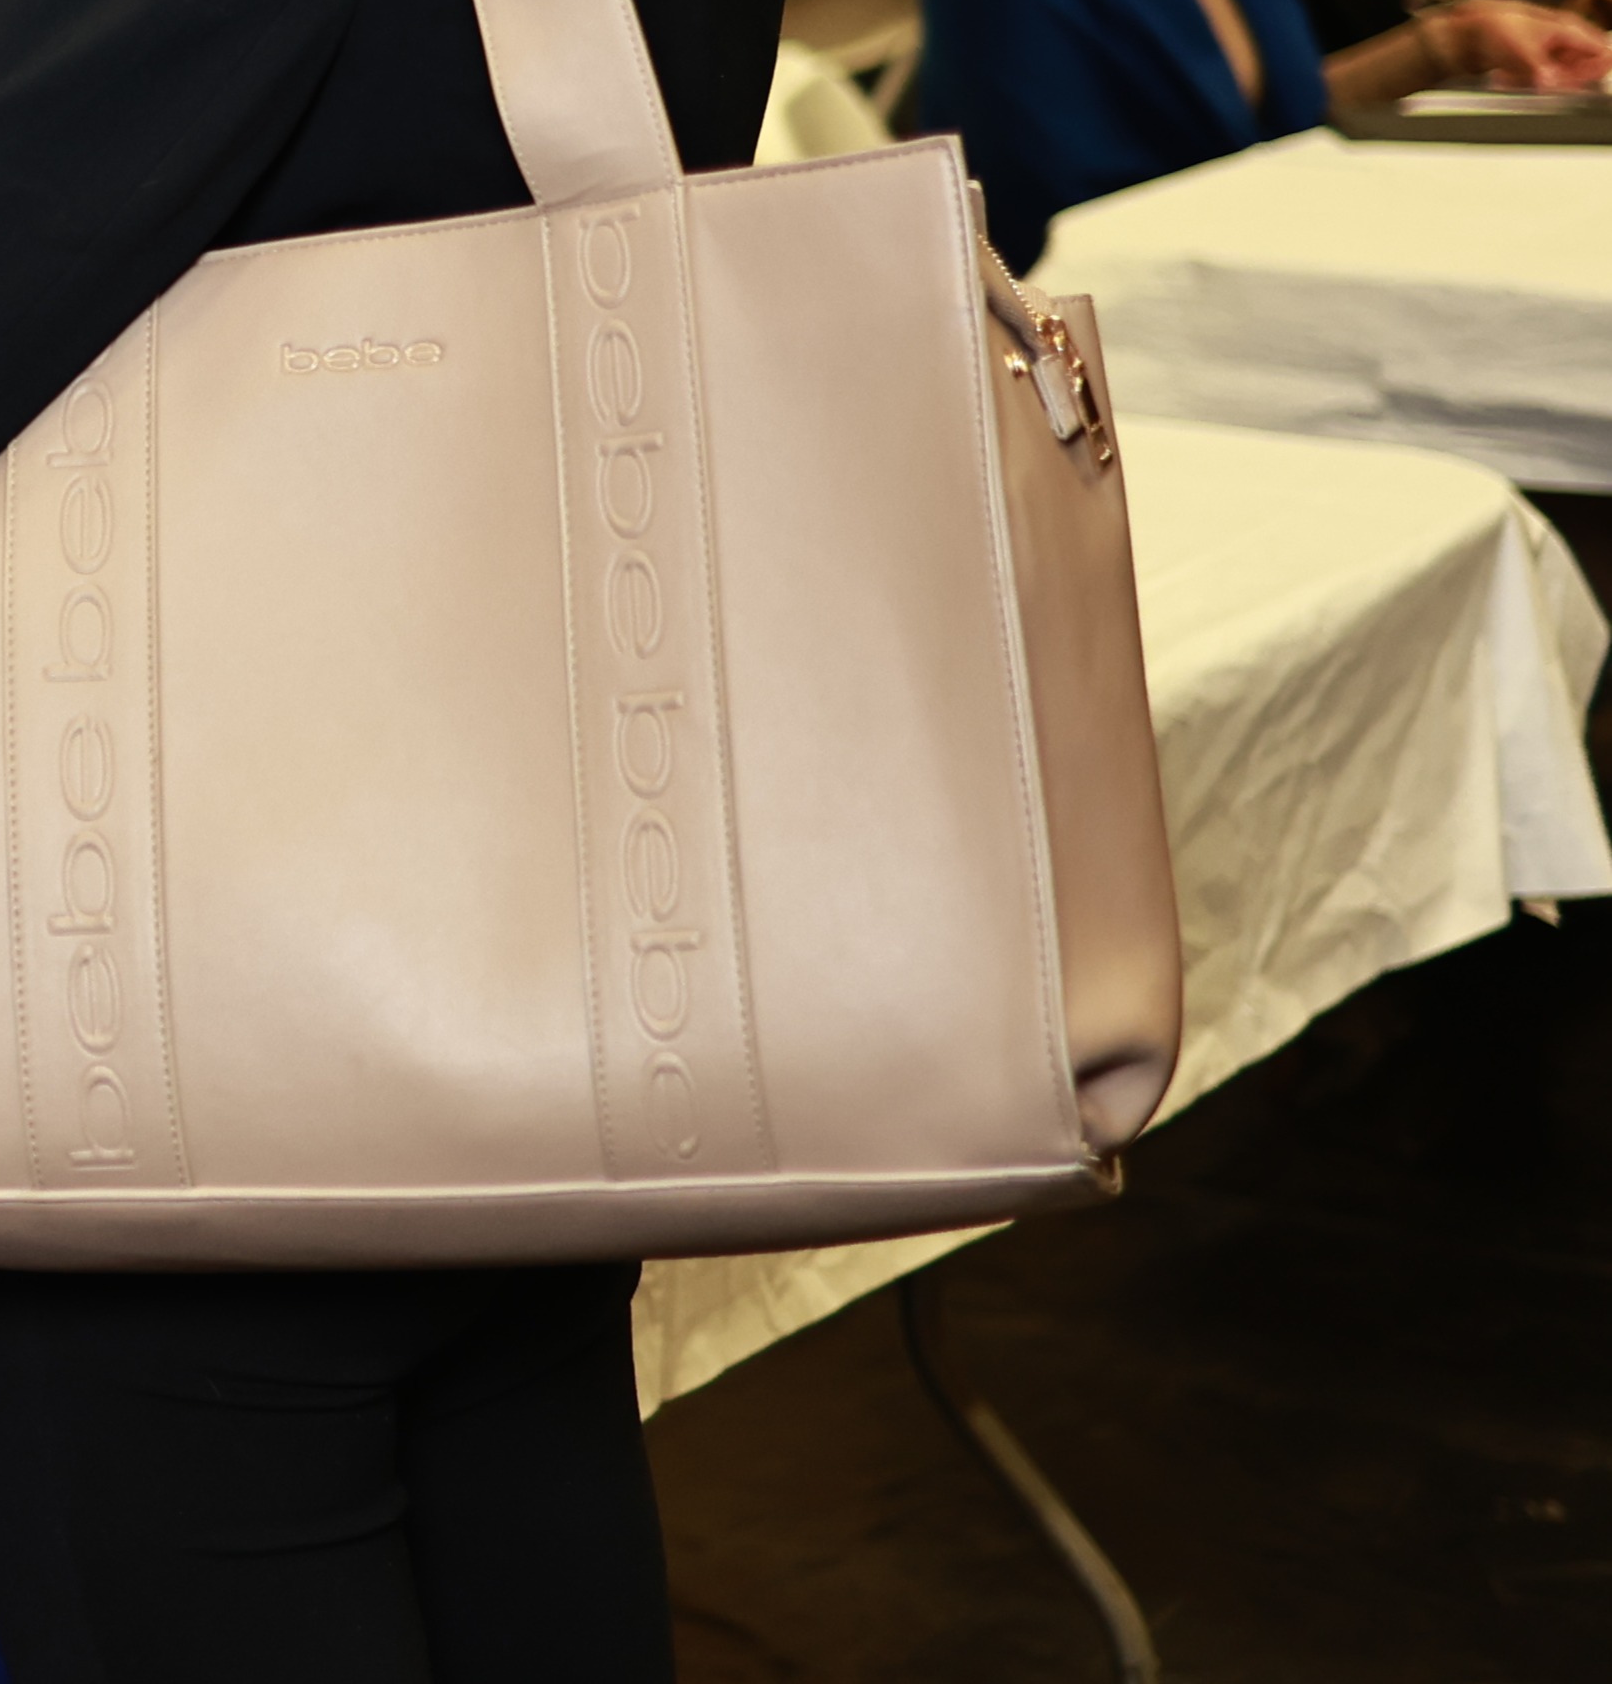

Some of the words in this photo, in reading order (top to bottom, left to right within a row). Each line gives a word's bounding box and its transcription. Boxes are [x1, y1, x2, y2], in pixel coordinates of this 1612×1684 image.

[41, 354, 116, 683] beb
[281, 337, 443, 374] bebe
[578, 202, 665, 663] bebe
[47, 714, 137, 1172] bebe
